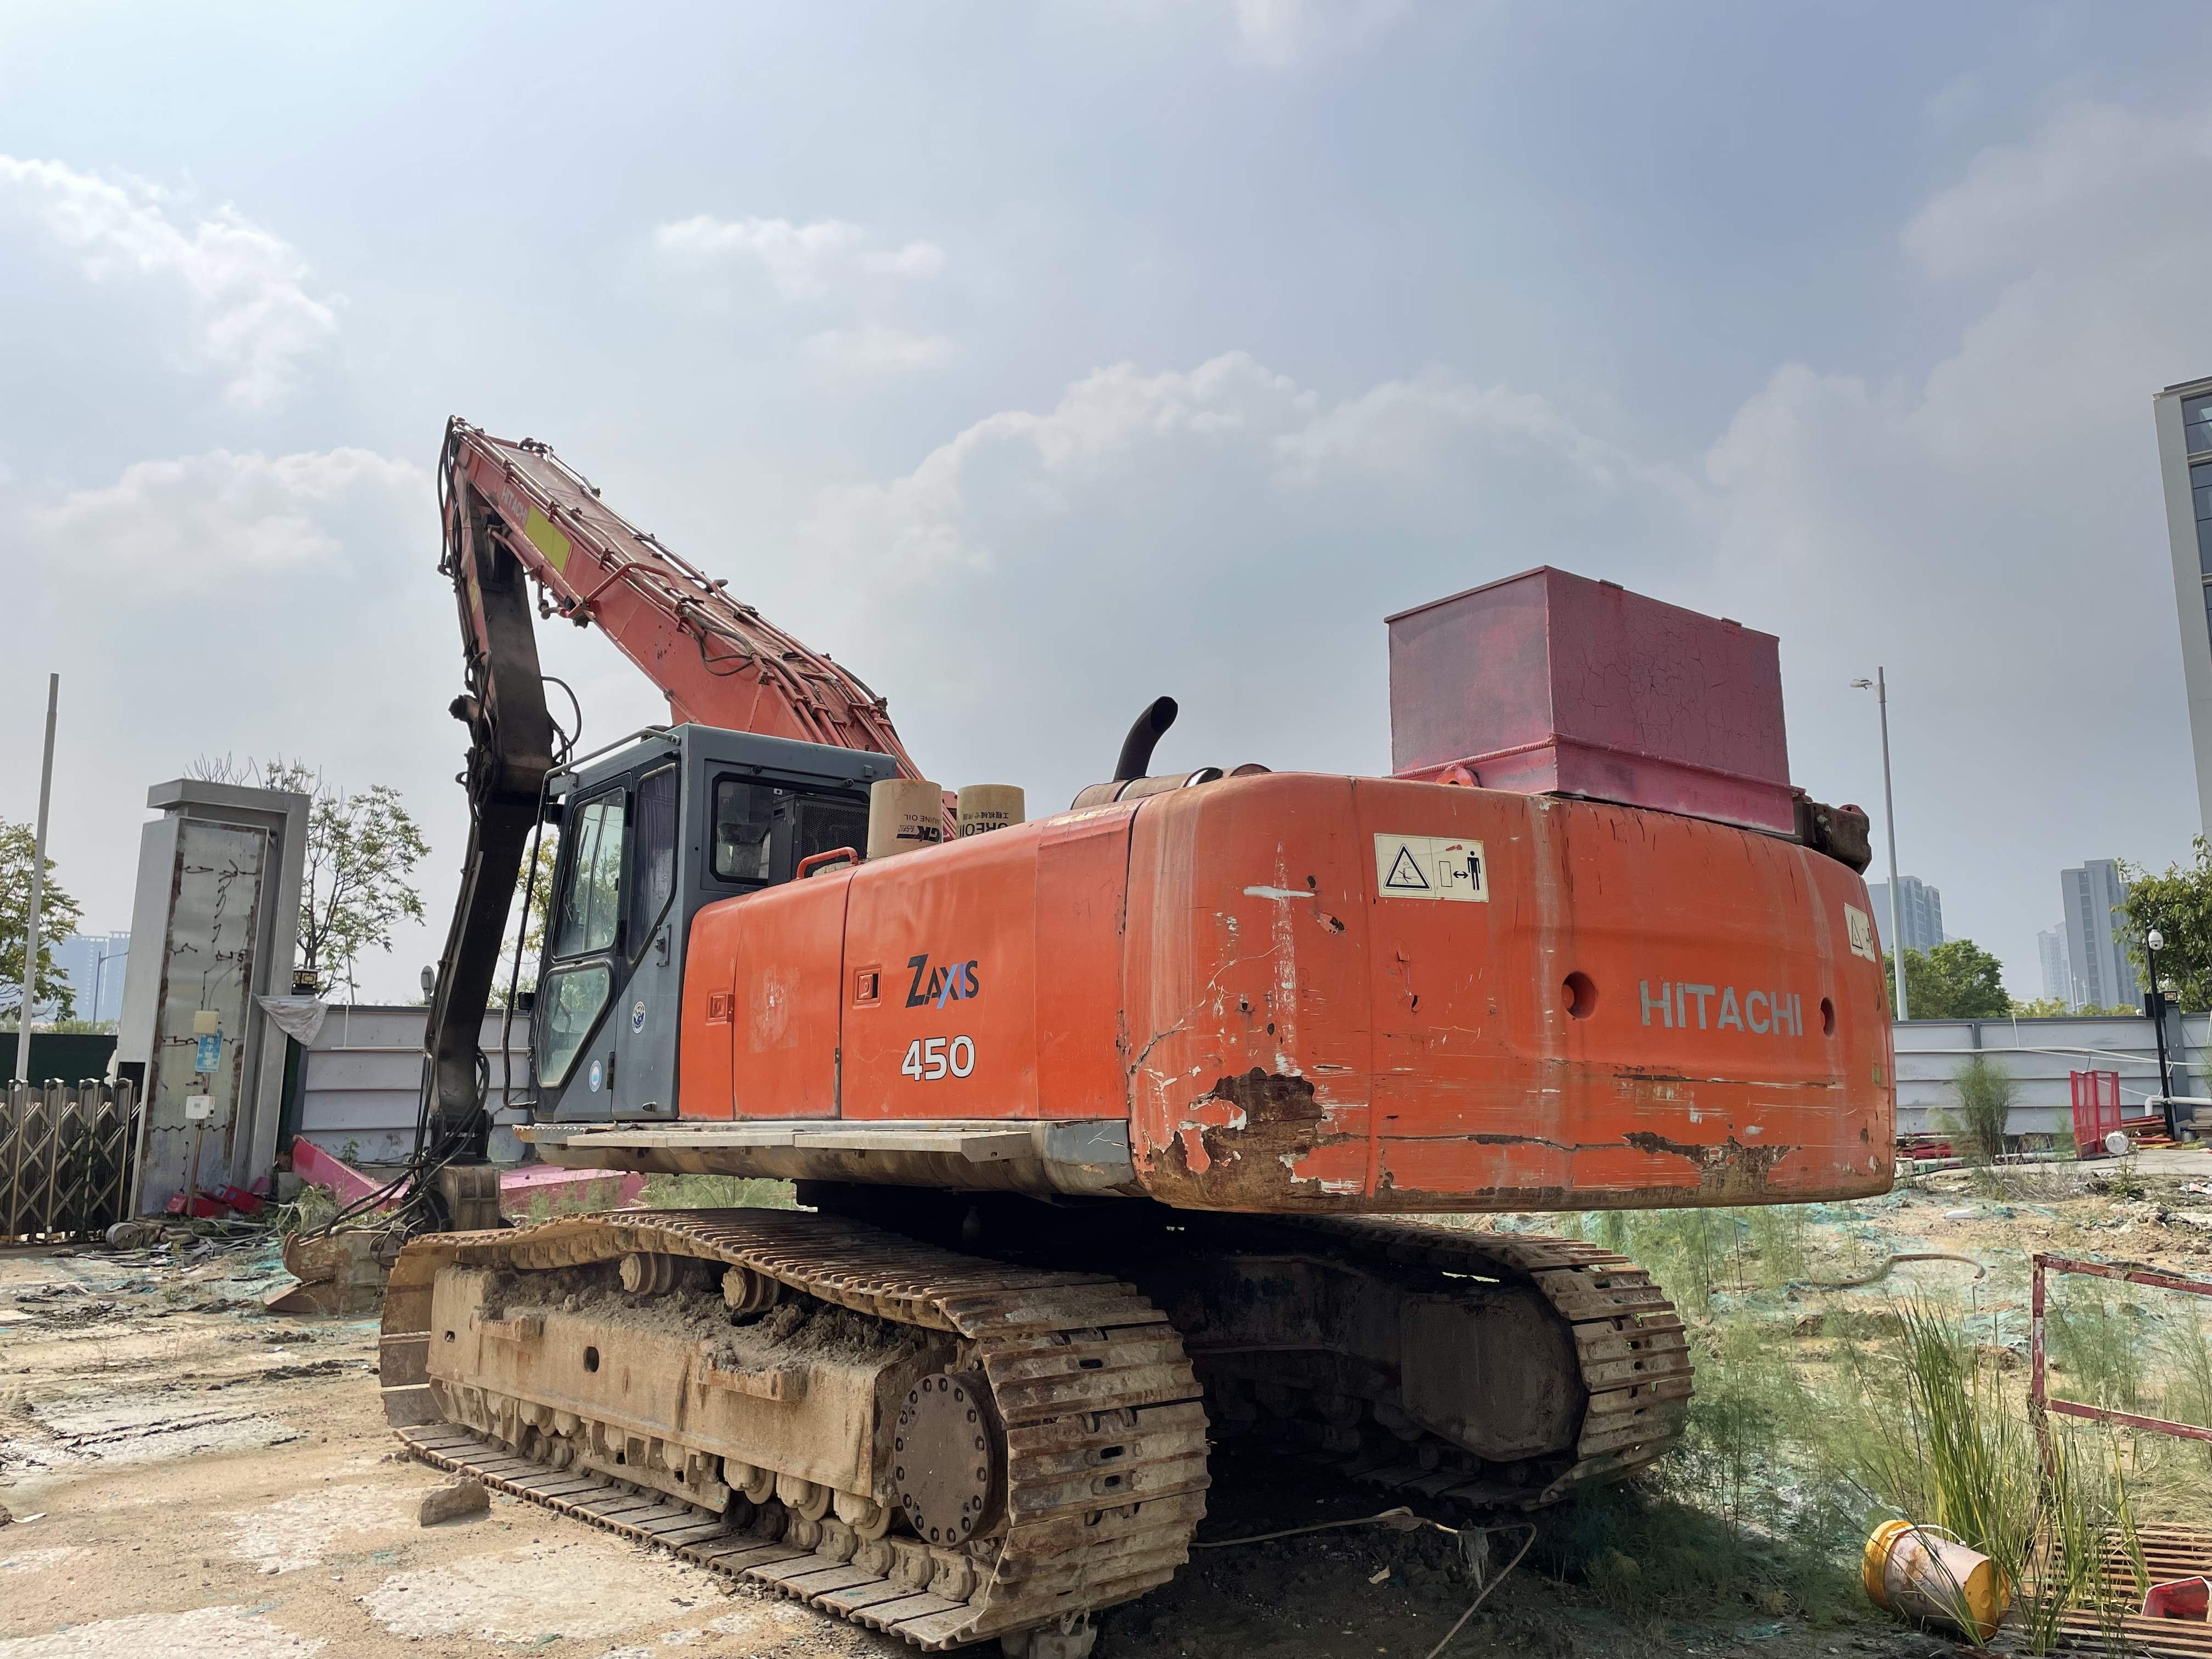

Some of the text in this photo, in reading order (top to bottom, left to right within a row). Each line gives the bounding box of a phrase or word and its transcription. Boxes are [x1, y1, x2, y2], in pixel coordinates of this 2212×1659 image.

[501, 486, 528, 524] HITACHI
[1639, 979, 1803, 1037] HITACHI
[900, 1035, 976, 1081] 450
